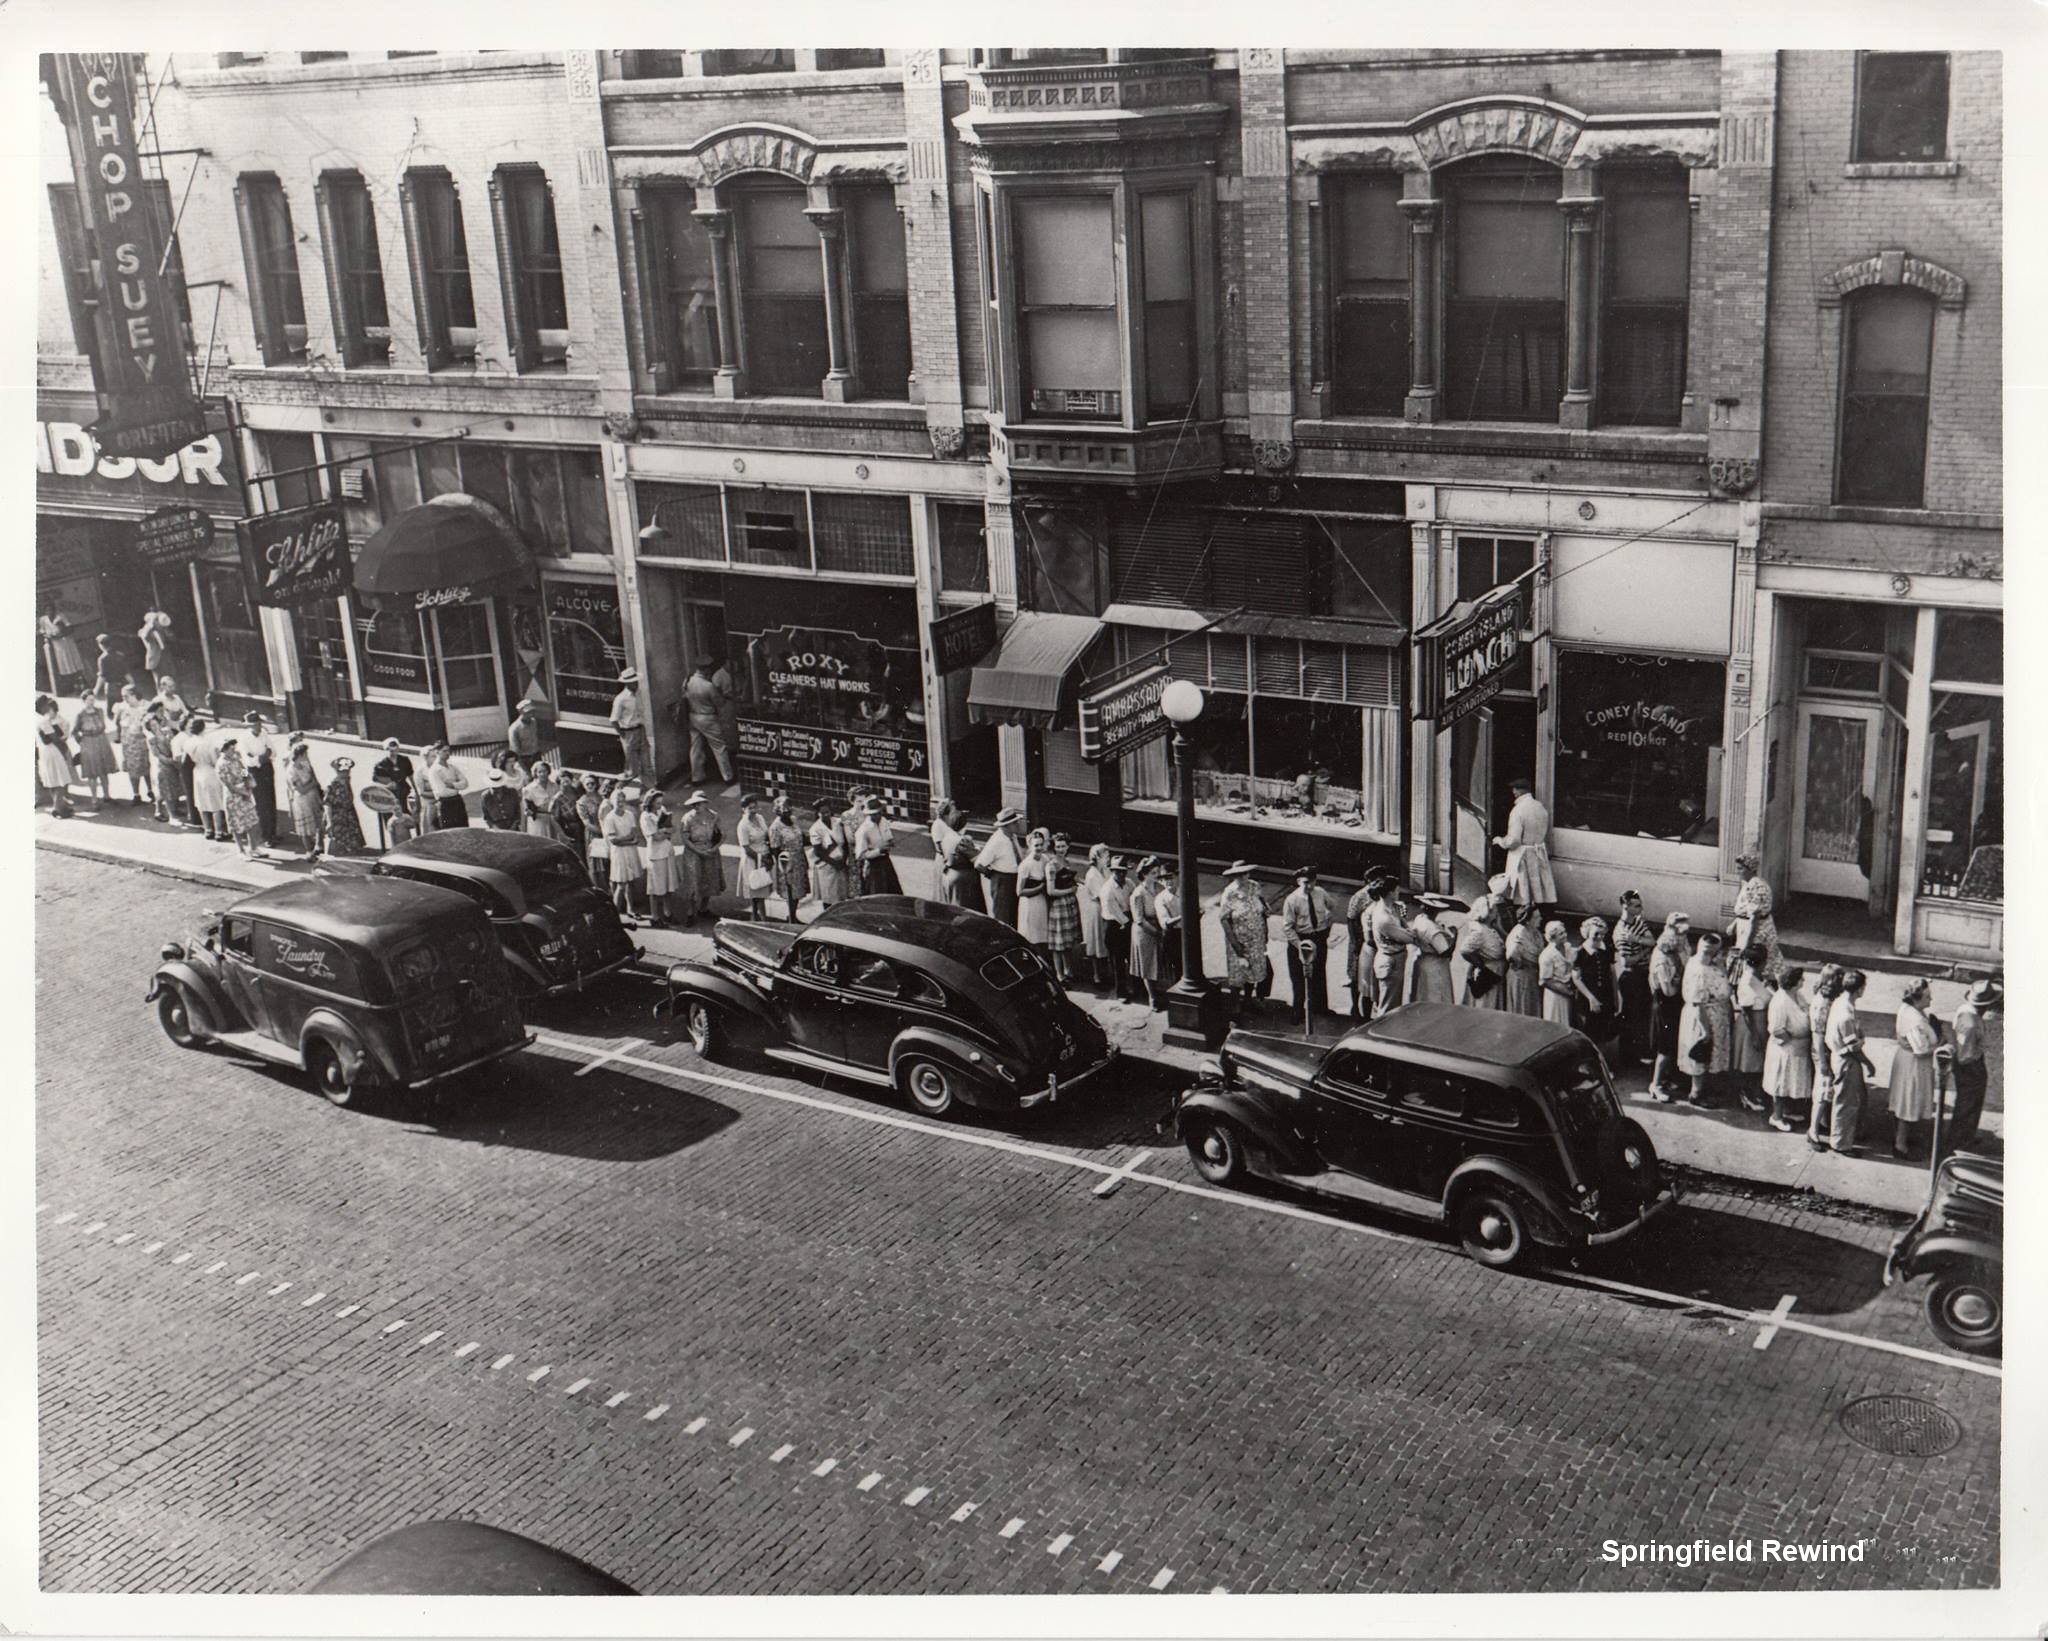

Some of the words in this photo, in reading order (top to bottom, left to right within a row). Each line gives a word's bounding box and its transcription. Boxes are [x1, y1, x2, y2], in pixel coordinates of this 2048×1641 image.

[87, 76, 132, 223] CHOP
[115, 243, 157, 383] SUEY
[266, 519, 340, 587] Schlitz
[415, 586, 471, 609] Schlitz
[556, 596, 612, 613] ALCOVE
[373, 664, 395, 675] GOOD
[396, 666, 416, 678] FOOD
[786, 652, 850, 676] ROXY
[1445, 627, 1516, 700] LUNCH
[768, 671, 817, 688] CLEANERS
[820, 678, 836, 689] HAT
[838, 679, 871, 693] WORKS
[1441, 711, 1454, 726] AIR
[1586, 704, 1631, 726] CONEY
[1637, 701, 1686, 734] ISLAND
[854, 737, 873, 748] SUITS
[1607, 732, 1627, 741] RED
[1649, 737, 1667, 746] HOT
[866, 749, 896, 759] PRESSED
[275, 944, 325, 972] Laundry
